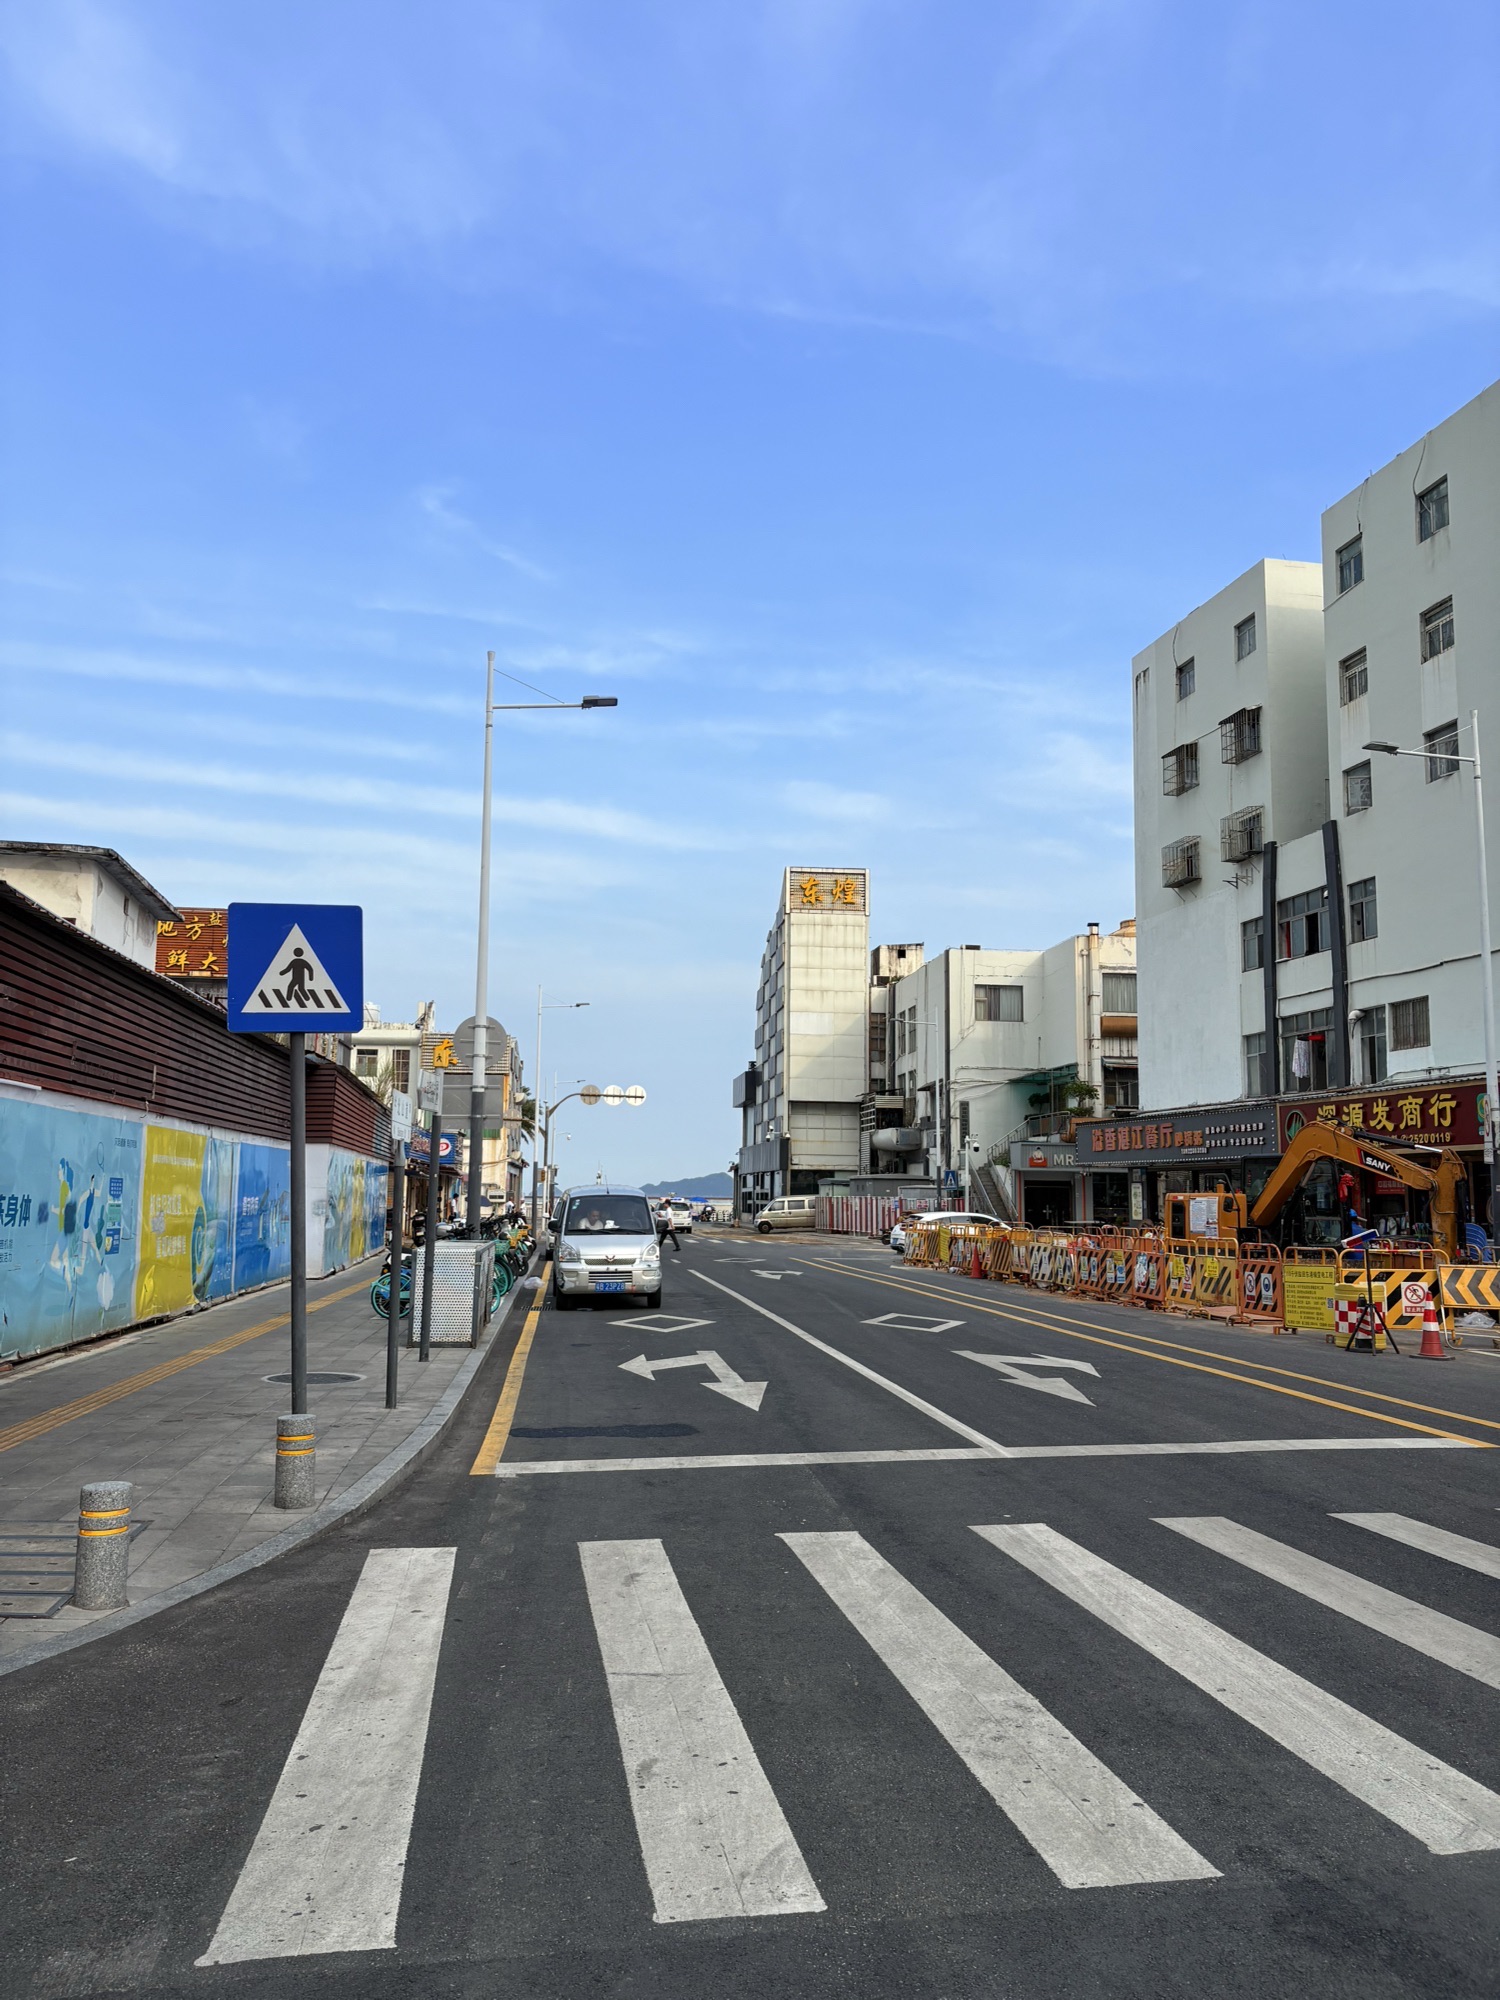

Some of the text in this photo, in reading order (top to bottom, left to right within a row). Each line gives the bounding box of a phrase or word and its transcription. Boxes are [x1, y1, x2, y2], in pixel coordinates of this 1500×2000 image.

[800, 877, 856, 904] 东煌
[1317, 1093, 1457, 1131] 深源发商行
[1366, 1157, 1391, 1171] SANY
